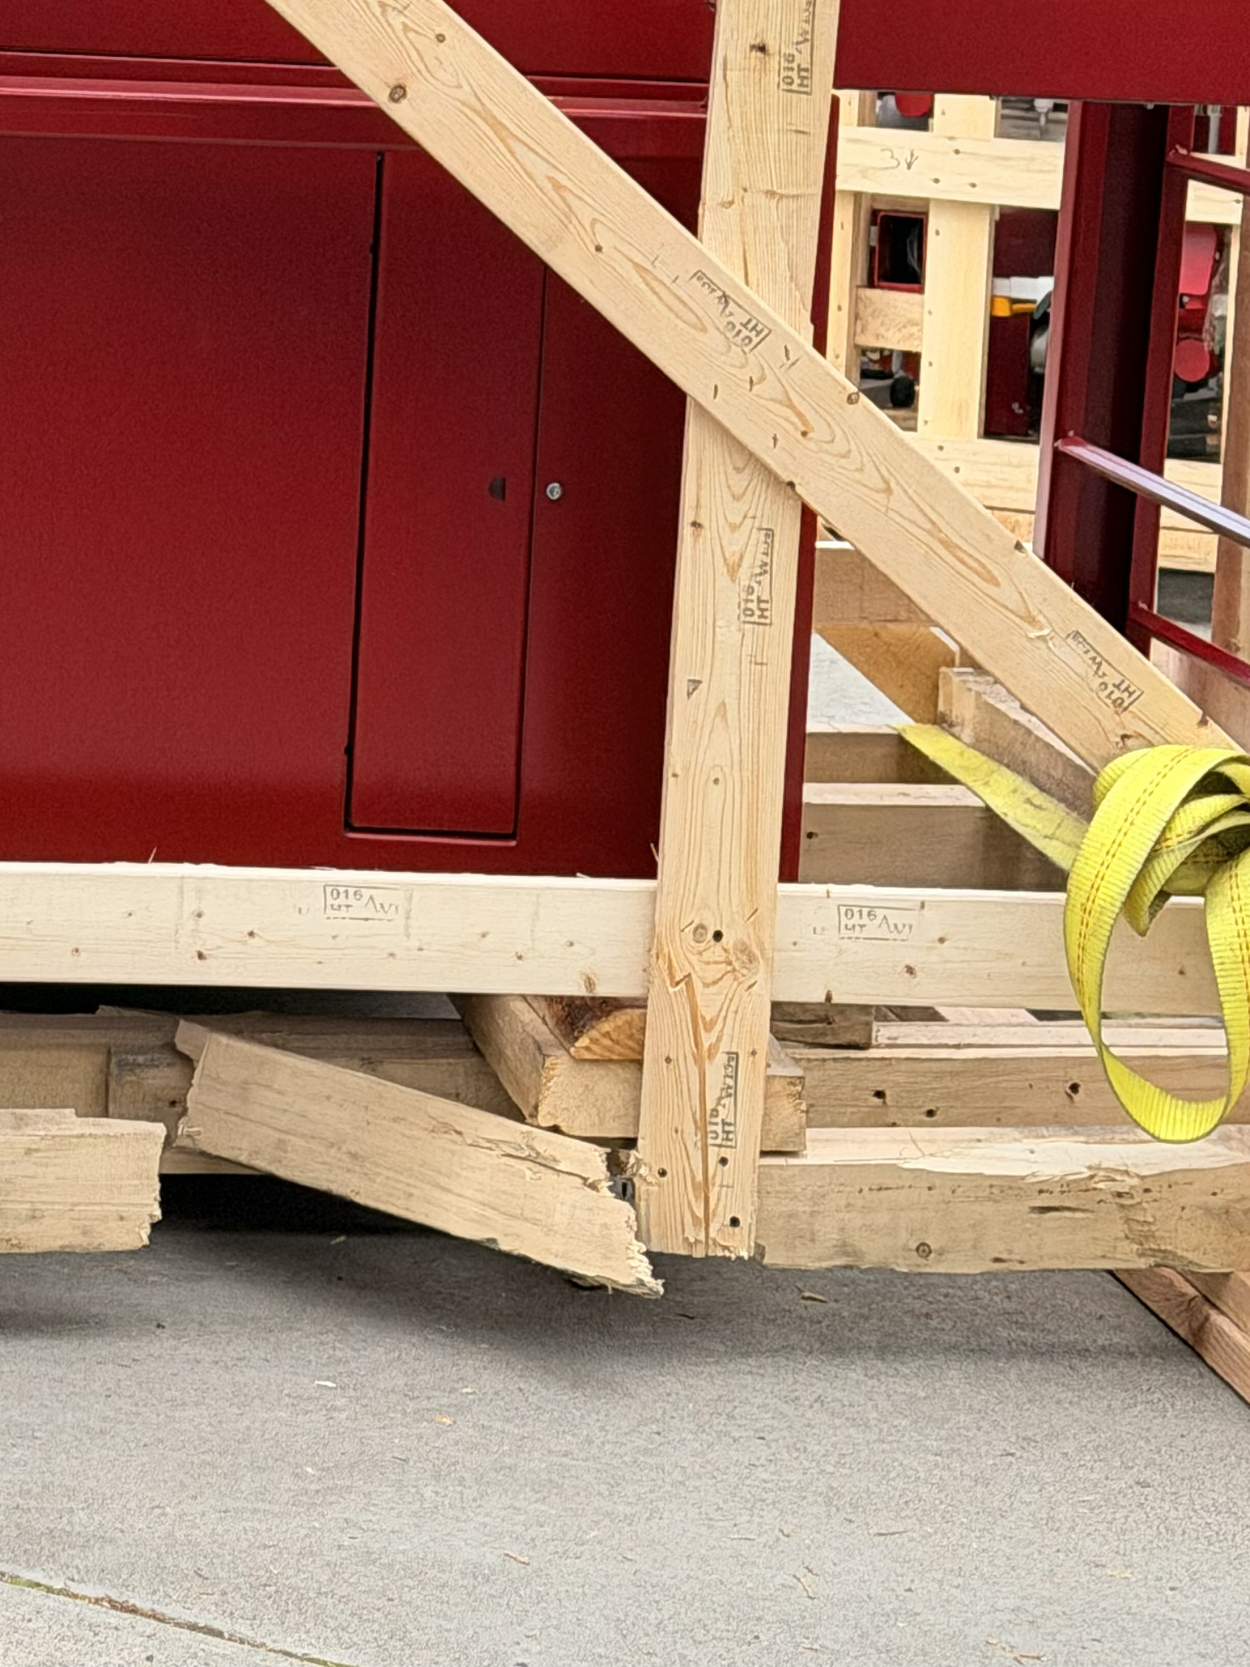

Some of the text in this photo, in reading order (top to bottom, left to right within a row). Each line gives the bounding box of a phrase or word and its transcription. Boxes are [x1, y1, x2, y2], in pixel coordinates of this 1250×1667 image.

[797, 63, 809, 88] HT
[739, 314, 765, 338] HT
[757, 595, 769, 620] HT
[1110, 675, 1137, 700] HT
[330, 888, 363, 901] 016
[845, 908, 878, 921] 016
[722, 1119, 734, 1142] HT
